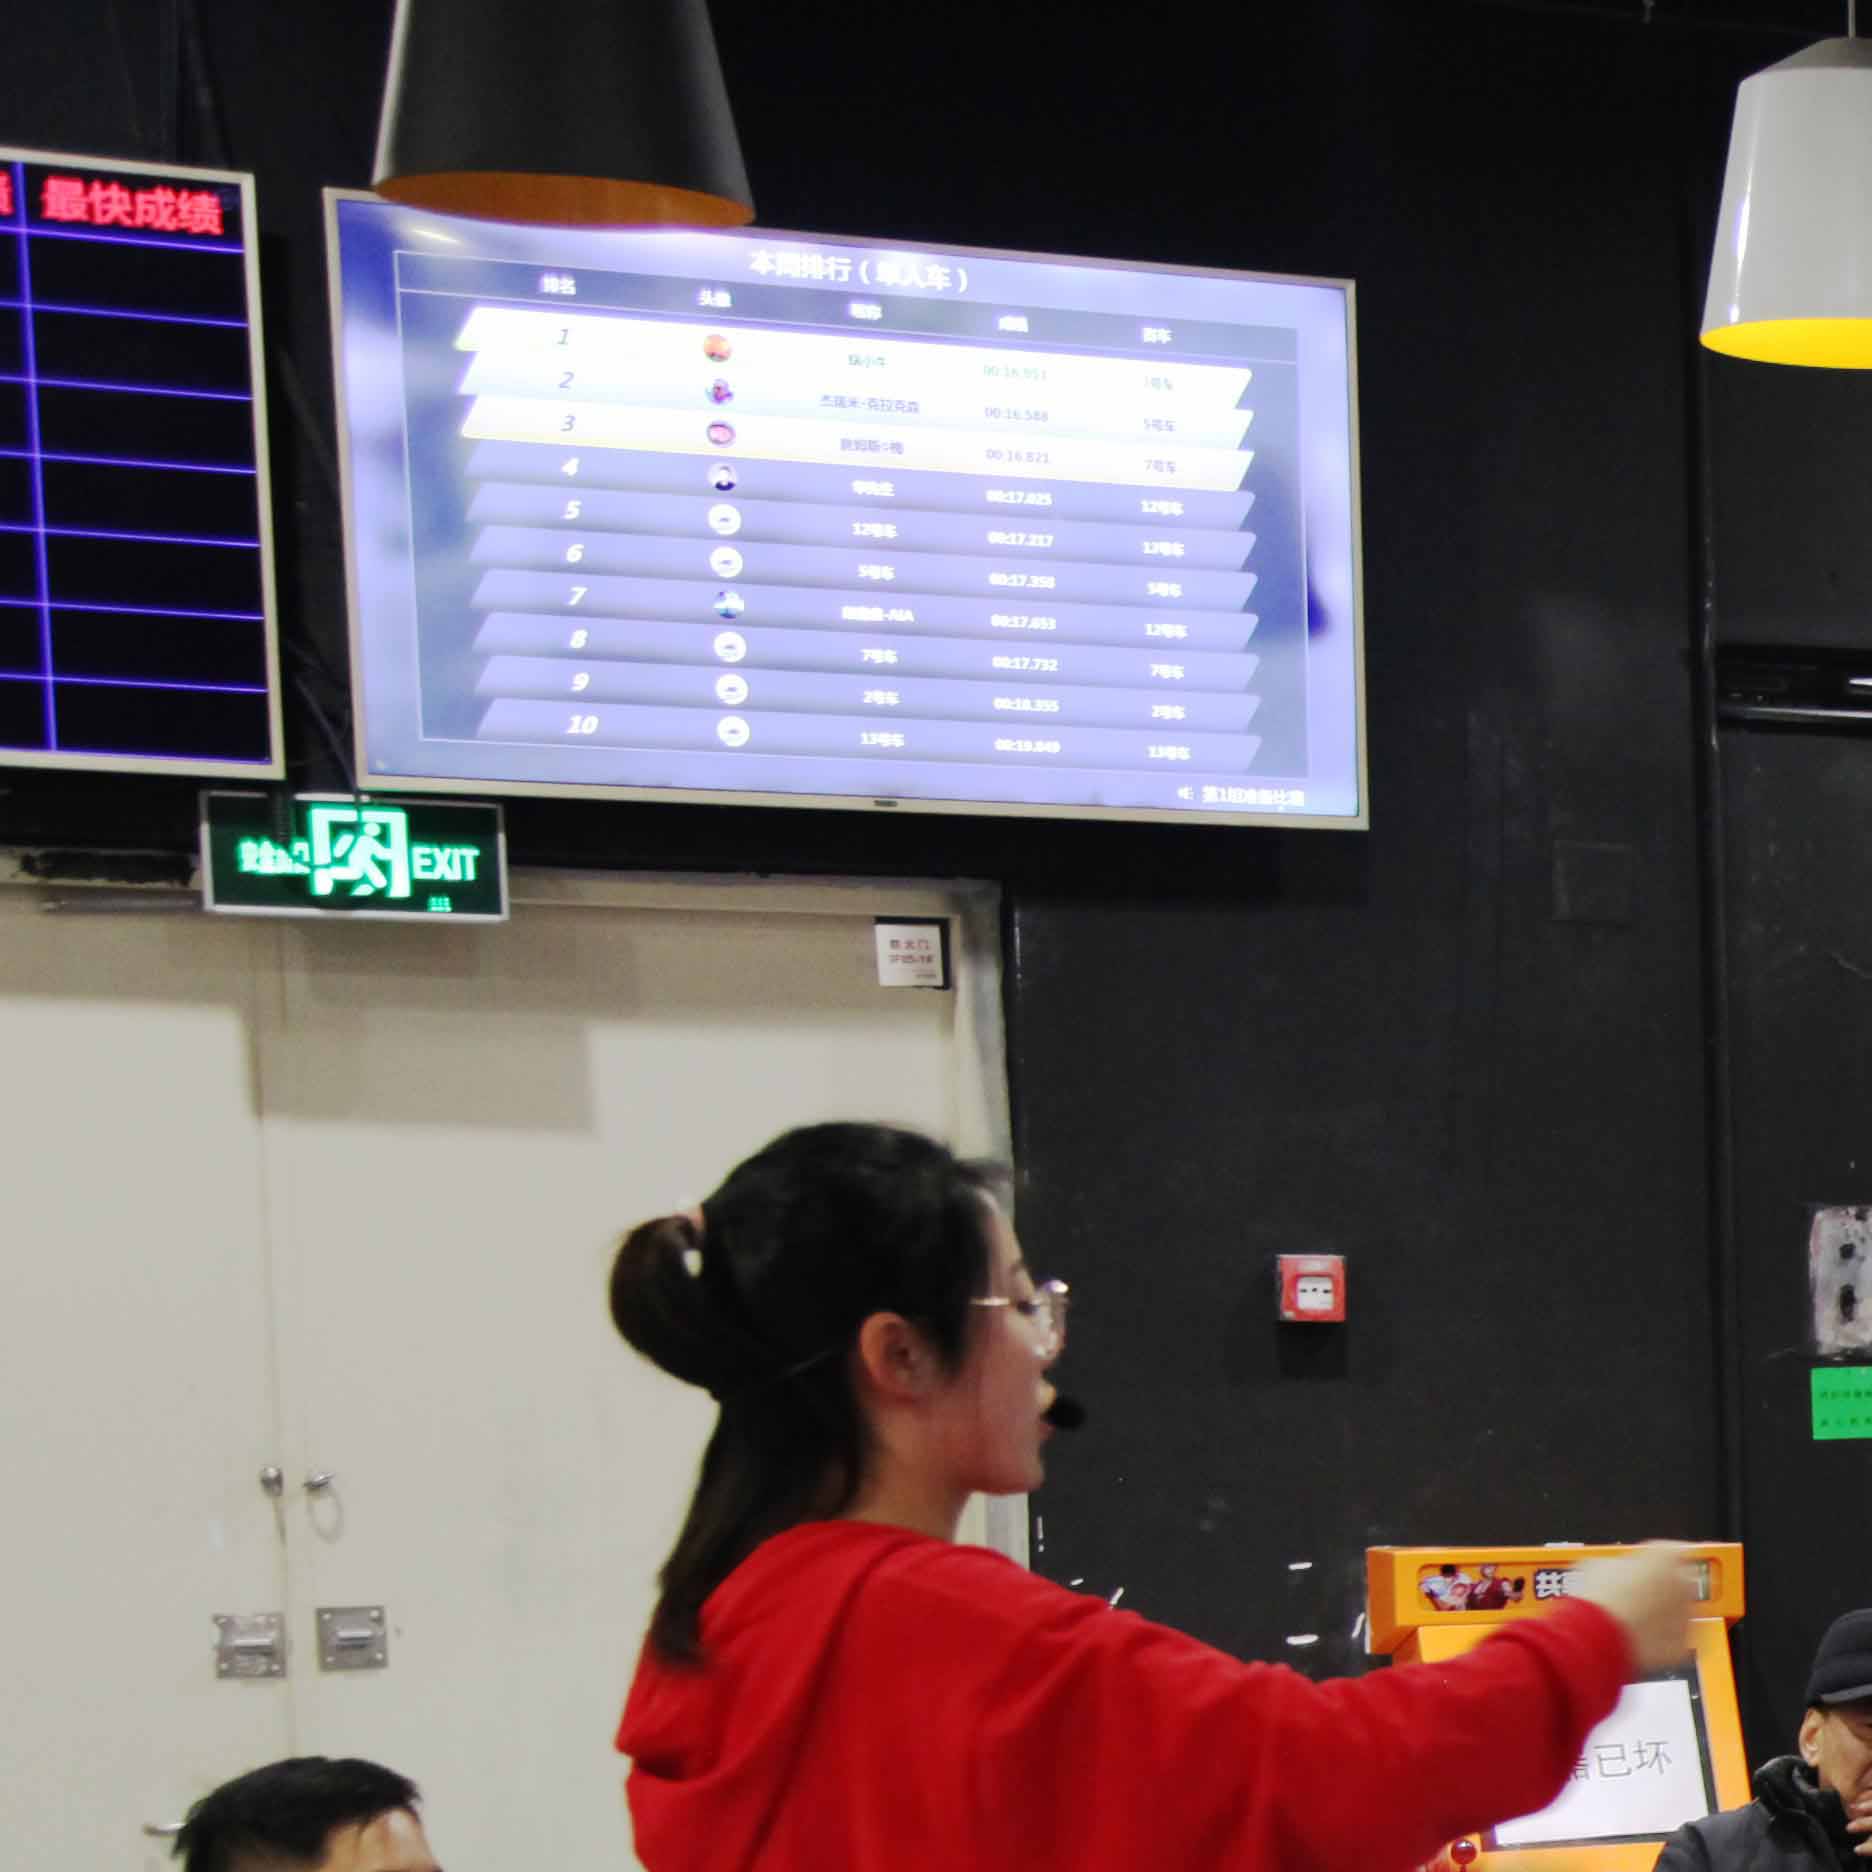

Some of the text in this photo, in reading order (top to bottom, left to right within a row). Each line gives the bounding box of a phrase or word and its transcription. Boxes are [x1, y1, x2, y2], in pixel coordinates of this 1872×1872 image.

[40, 175, 224, 236] 最快成绩
[556, 328, 570, 346] 1
[558, 371, 575, 389] 2
[560, 415, 577, 432] 3
[561, 457, 579, 476] 4
[563, 500, 582, 519] 5
[566, 543, 585, 563] 6
[569, 586, 588, 606] 7
[569, 629, 588, 649] 8
[571, 672, 590, 691] 9
[567, 715, 599, 734] 10
[413, 846, 480, 881] EXIT
